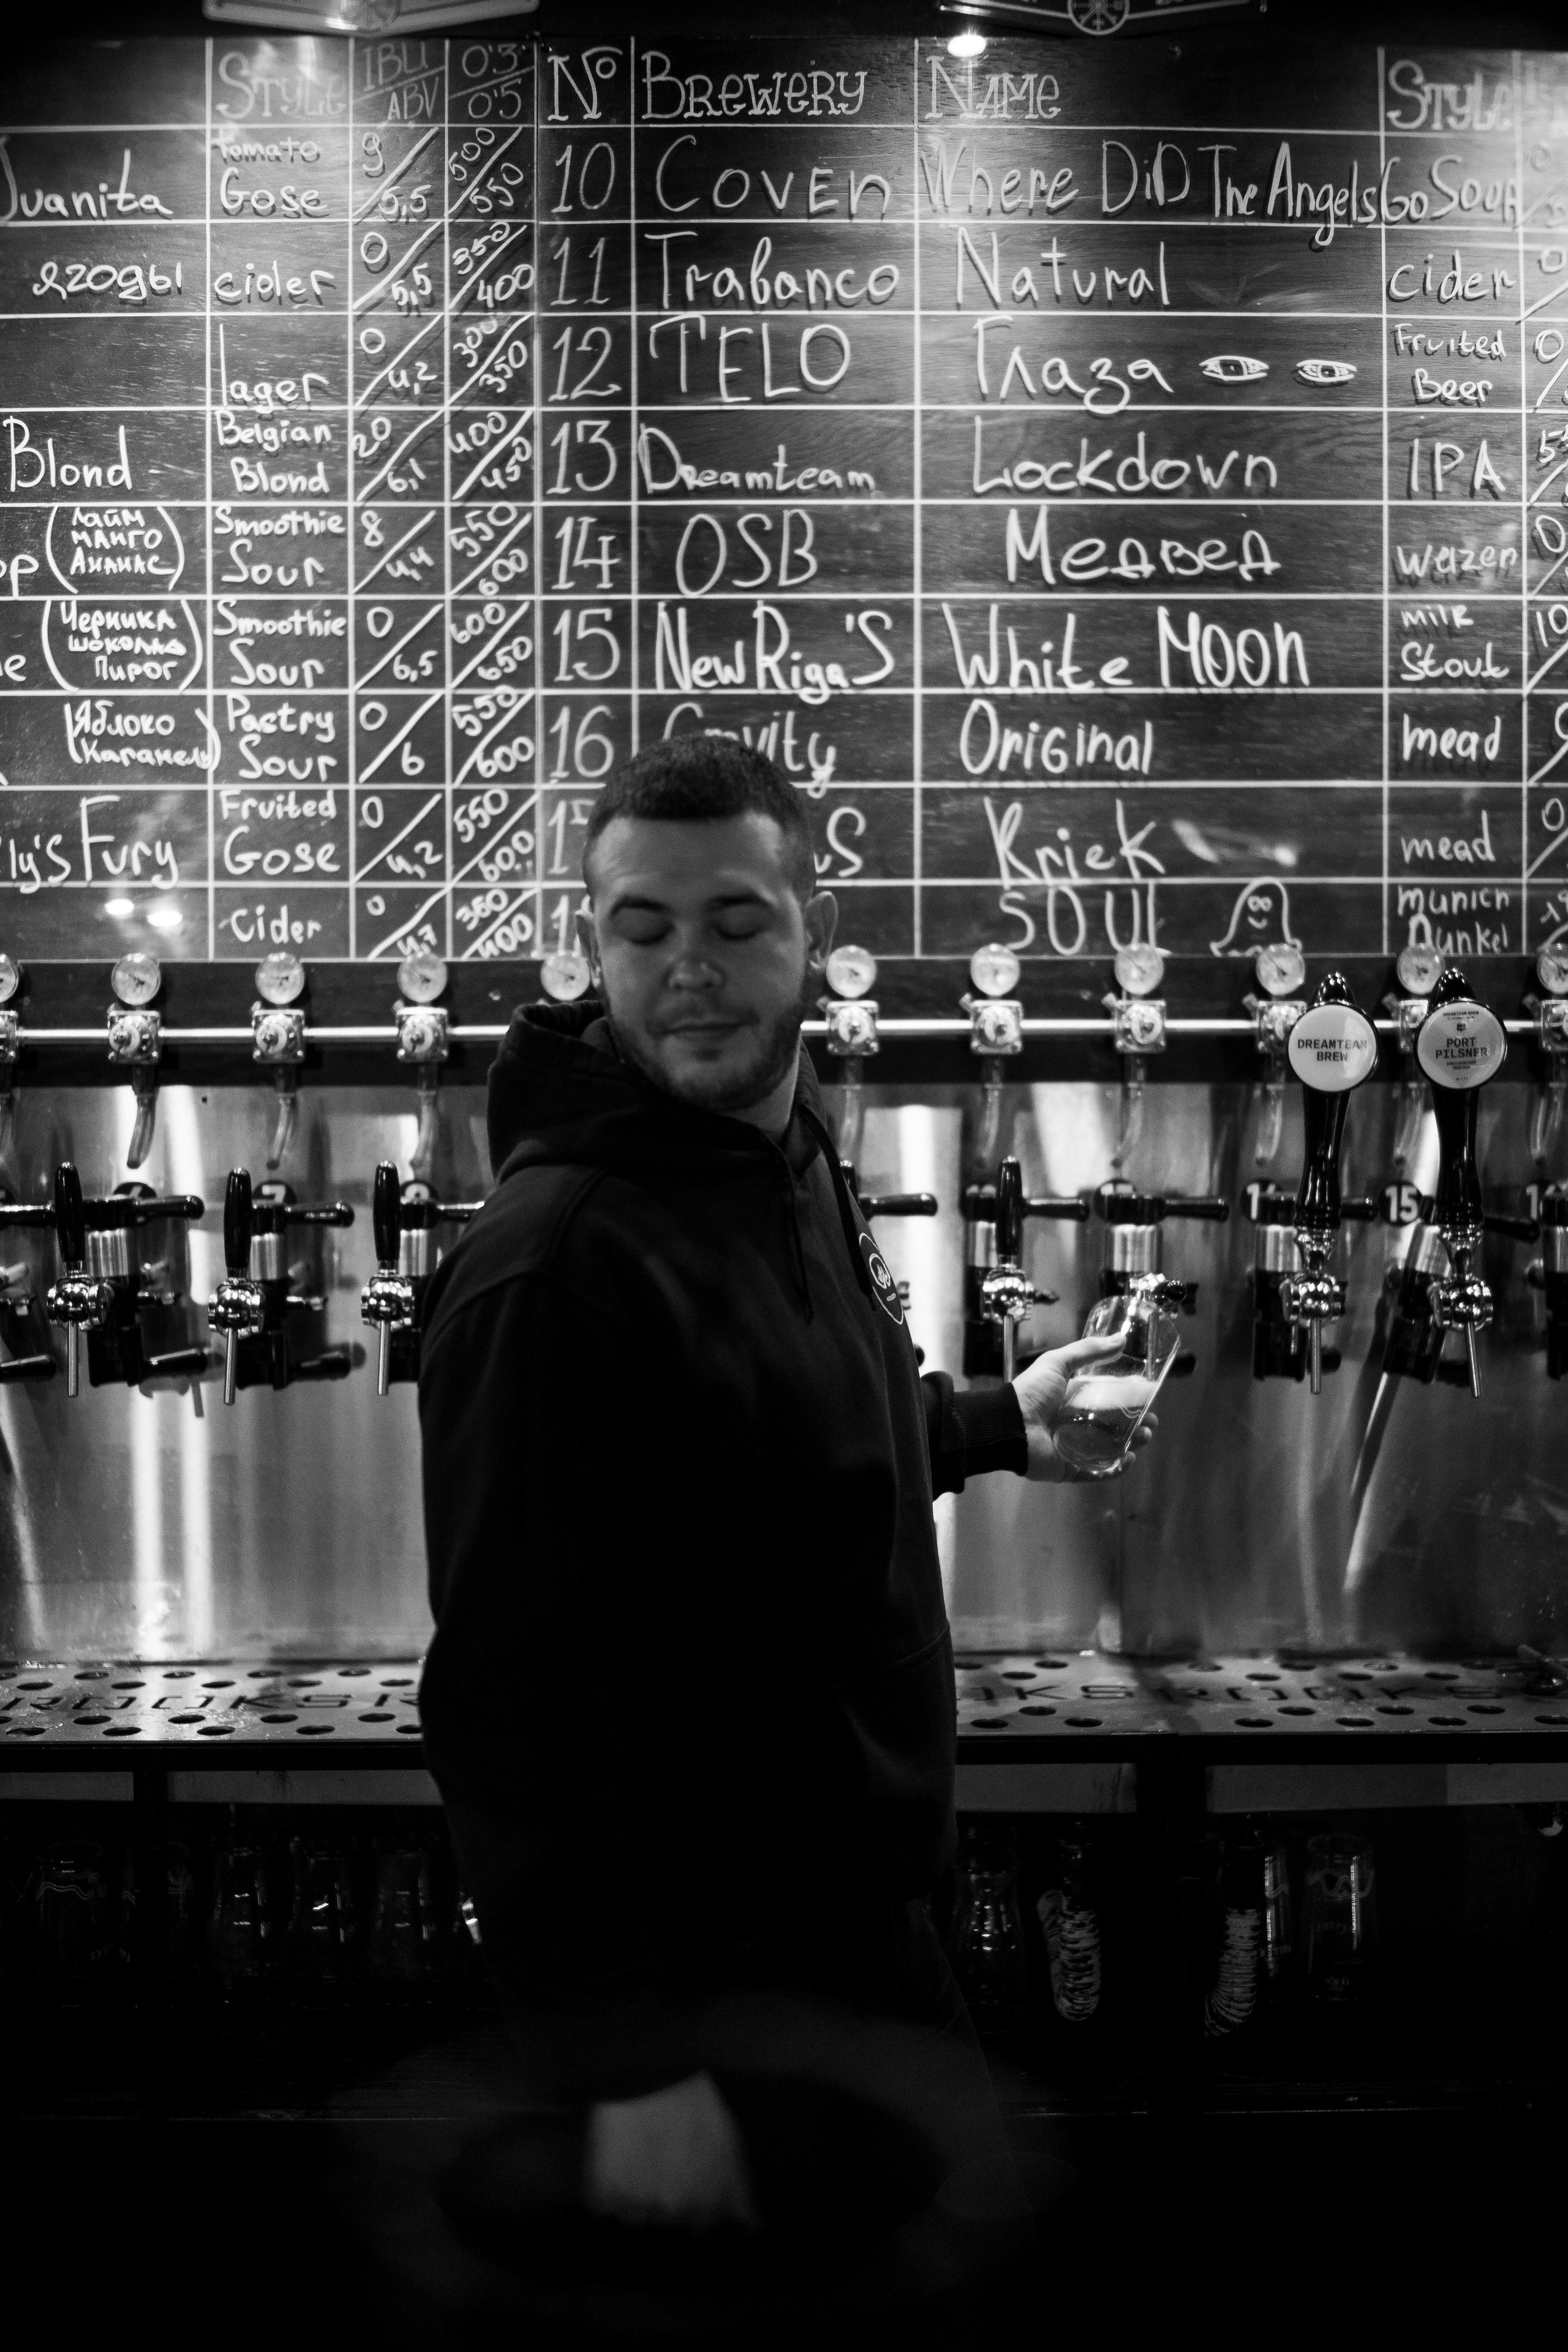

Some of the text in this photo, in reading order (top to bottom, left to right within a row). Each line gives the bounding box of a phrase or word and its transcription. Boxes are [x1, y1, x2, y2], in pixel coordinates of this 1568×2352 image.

[364, 41, 428, 91] IBU
[388, 77, 439, 119] ABV
[361, 132, 383, 172] 9
[448, 127, 496, 181] 500
[219, 167, 328, 213] Gose
[379, 185, 431, 216] 5,5
[469, 162, 524, 213] 550
[551, 142, 615, 213] 10
[920, 139, 1079, 215] Where
[1197, 145, 1257, 217] The
[1267, 141, 1377, 246] Angels
[1381, 156, 1429, 222] Go
[360, 231, 388, 264] 0
[451, 221, 510, 274] 350
[643, 231, 900, 309] Trabanco
[956, 226, 1170, 306] Natural
[391, 262, 432, 306] 5,5
[477, 263, 535, 308] 400
[551, 237, 611, 306] 11
[360, 327, 386, 355] 0
[453, 318, 498, 368] 300
[649, 314, 851, 404] TELO
[1394, 323, 1507, 357] Fruited
[1535, 328, 1565, 360] 0
[388, 361, 438, 395] 4,2
[478, 340, 528, 393] 350
[548, 326, 622, 402] 12
[972, 315, 1174, 415] Глаза
[1415, 368, 1493, 401] Beer
[2, 415, 132, 492] Blond
[214, 409, 333, 452] Belgian
[351, 417, 392, 458] 20
[448, 411, 507, 454] 400
[973, 415, 1277, 493] Lockdown
[230, 457, 331, 493] Blond
[481, 436, 532, 489] 450
[545, 420, 617, 495] 13
[1411, 438, 1507, 492] IPA
[214, 505, 346, 537] Smoothie
[360, 510, 385, 548] 8
[448, 502, 518, 558] 550
[1535, 514, 1566, 553] 0
[221, 538, 325, 587] Sour
[478, 549, 529, 597] 600
[551, 516, 621, 590] 14
[676, 508, 818, 597] OSB
[213, 598, 347, 637] Smoothie
[367, 606, 394, 638] 0
[449, 602, 507, 645] 600
[230, 638, 325, 689] Sour
[393, 650, 439, 683] 6,5
[552, 608, 621, 682] 15
[655, 601, 747, 692] New
[941, 601, 1133, 690] White
[1400, 641, 1510, 682] Stout
[227, 692, 336, 743] Pastry
[359, 701, 388, 731] 0
[451, 684, 518, 736] 550
[238, 734, 337, 782] Sour
[401, 741, 426, 775] 6
[476, 736, 535, 778] 600
[549, 705, 614, 777] 16
[220, 788, 337, 820] Fruited
[361, 796, 385, 829] 0
[453, 788, 510, 843] 550
[1540, 797, 1566, 832] 0
[80, 794, 179, 890] Fury
[224, 825, 341, 876] Gose
[385, 840, 443, 880] 4,2
[984, 795, 1165, 891] Kriek
[366, 894, 386, 916] 0
[1297, 1039, 1367, 1050] DREAMTEAM
[1316, 1051, 1348, 1062] BREW
[1446, 1036, 1477, 1048] PORT
[1385, 1185, 1420, 1224] 15
